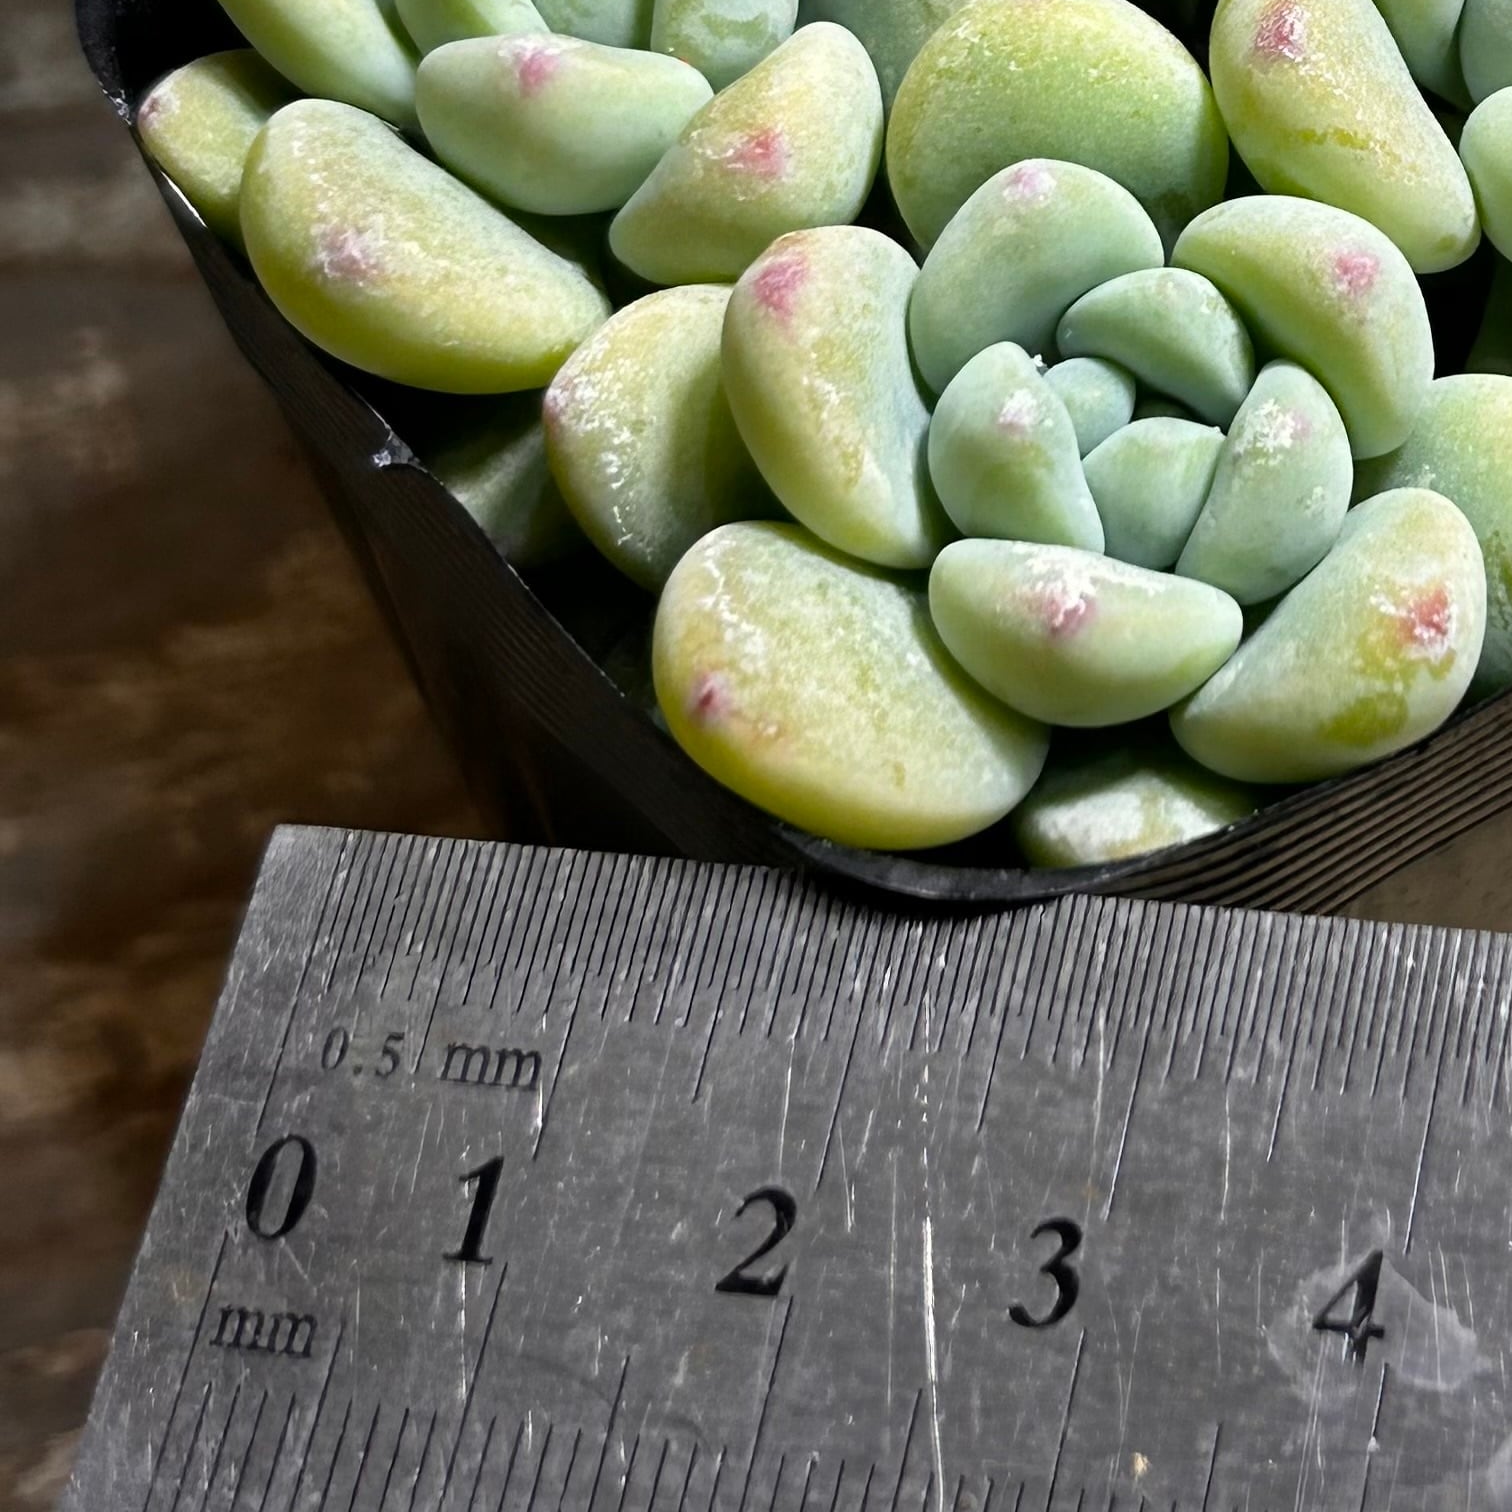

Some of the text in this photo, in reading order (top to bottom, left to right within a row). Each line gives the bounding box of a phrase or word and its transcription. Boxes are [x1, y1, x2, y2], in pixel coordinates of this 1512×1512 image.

[320, 1026, 543, 1089] 0.5 mm
[244, 1134, 318, 1241] 0
[443, 1155, 504, 1265] 1
[714, 1185, 798, 1297] 2
[1006, 1216, 1083, 1329] 3
[1311, 1249, 1387, 1364] 4
[210, 1302, 319, 1359] mm
